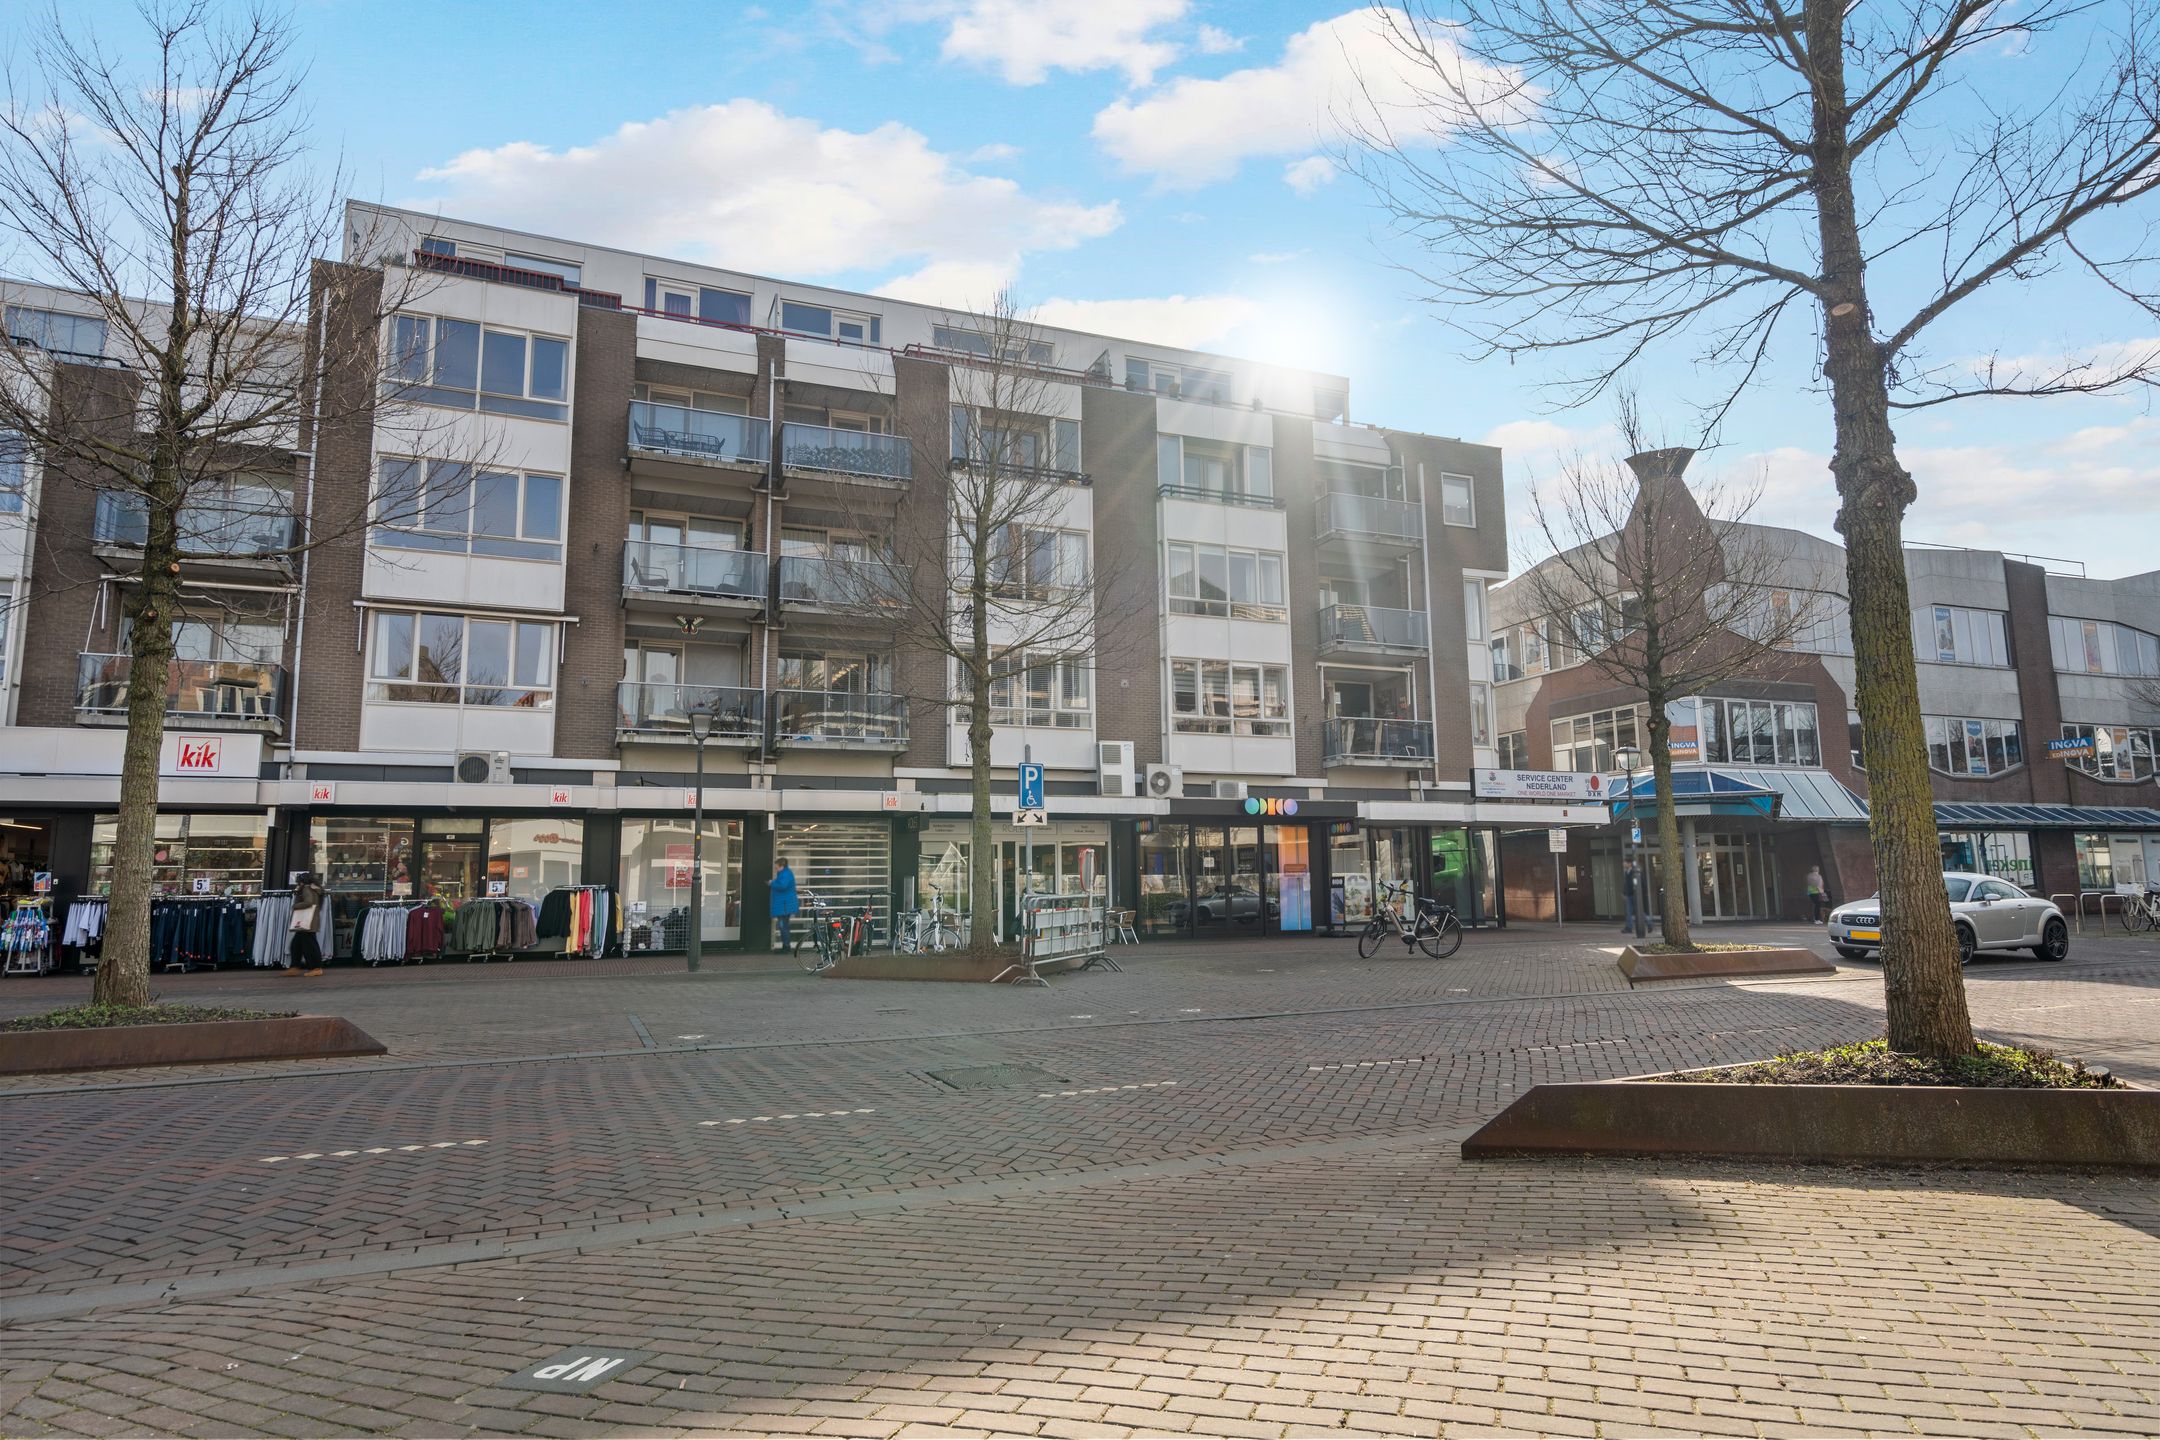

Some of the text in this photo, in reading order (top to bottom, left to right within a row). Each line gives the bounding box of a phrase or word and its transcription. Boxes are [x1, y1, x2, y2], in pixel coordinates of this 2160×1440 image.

[2051, 738, 2088, 750] INOVA
[180, 741, 217, 768] kik
[1025, 767, 1038, 789] P
[1516, 774, 1574, 783] SERVICE CENTER
[1526, 782, 1567, 791] NEDERLAND
[313, 787, 330, 800] kik
[553, 792, 568, 803] kik
